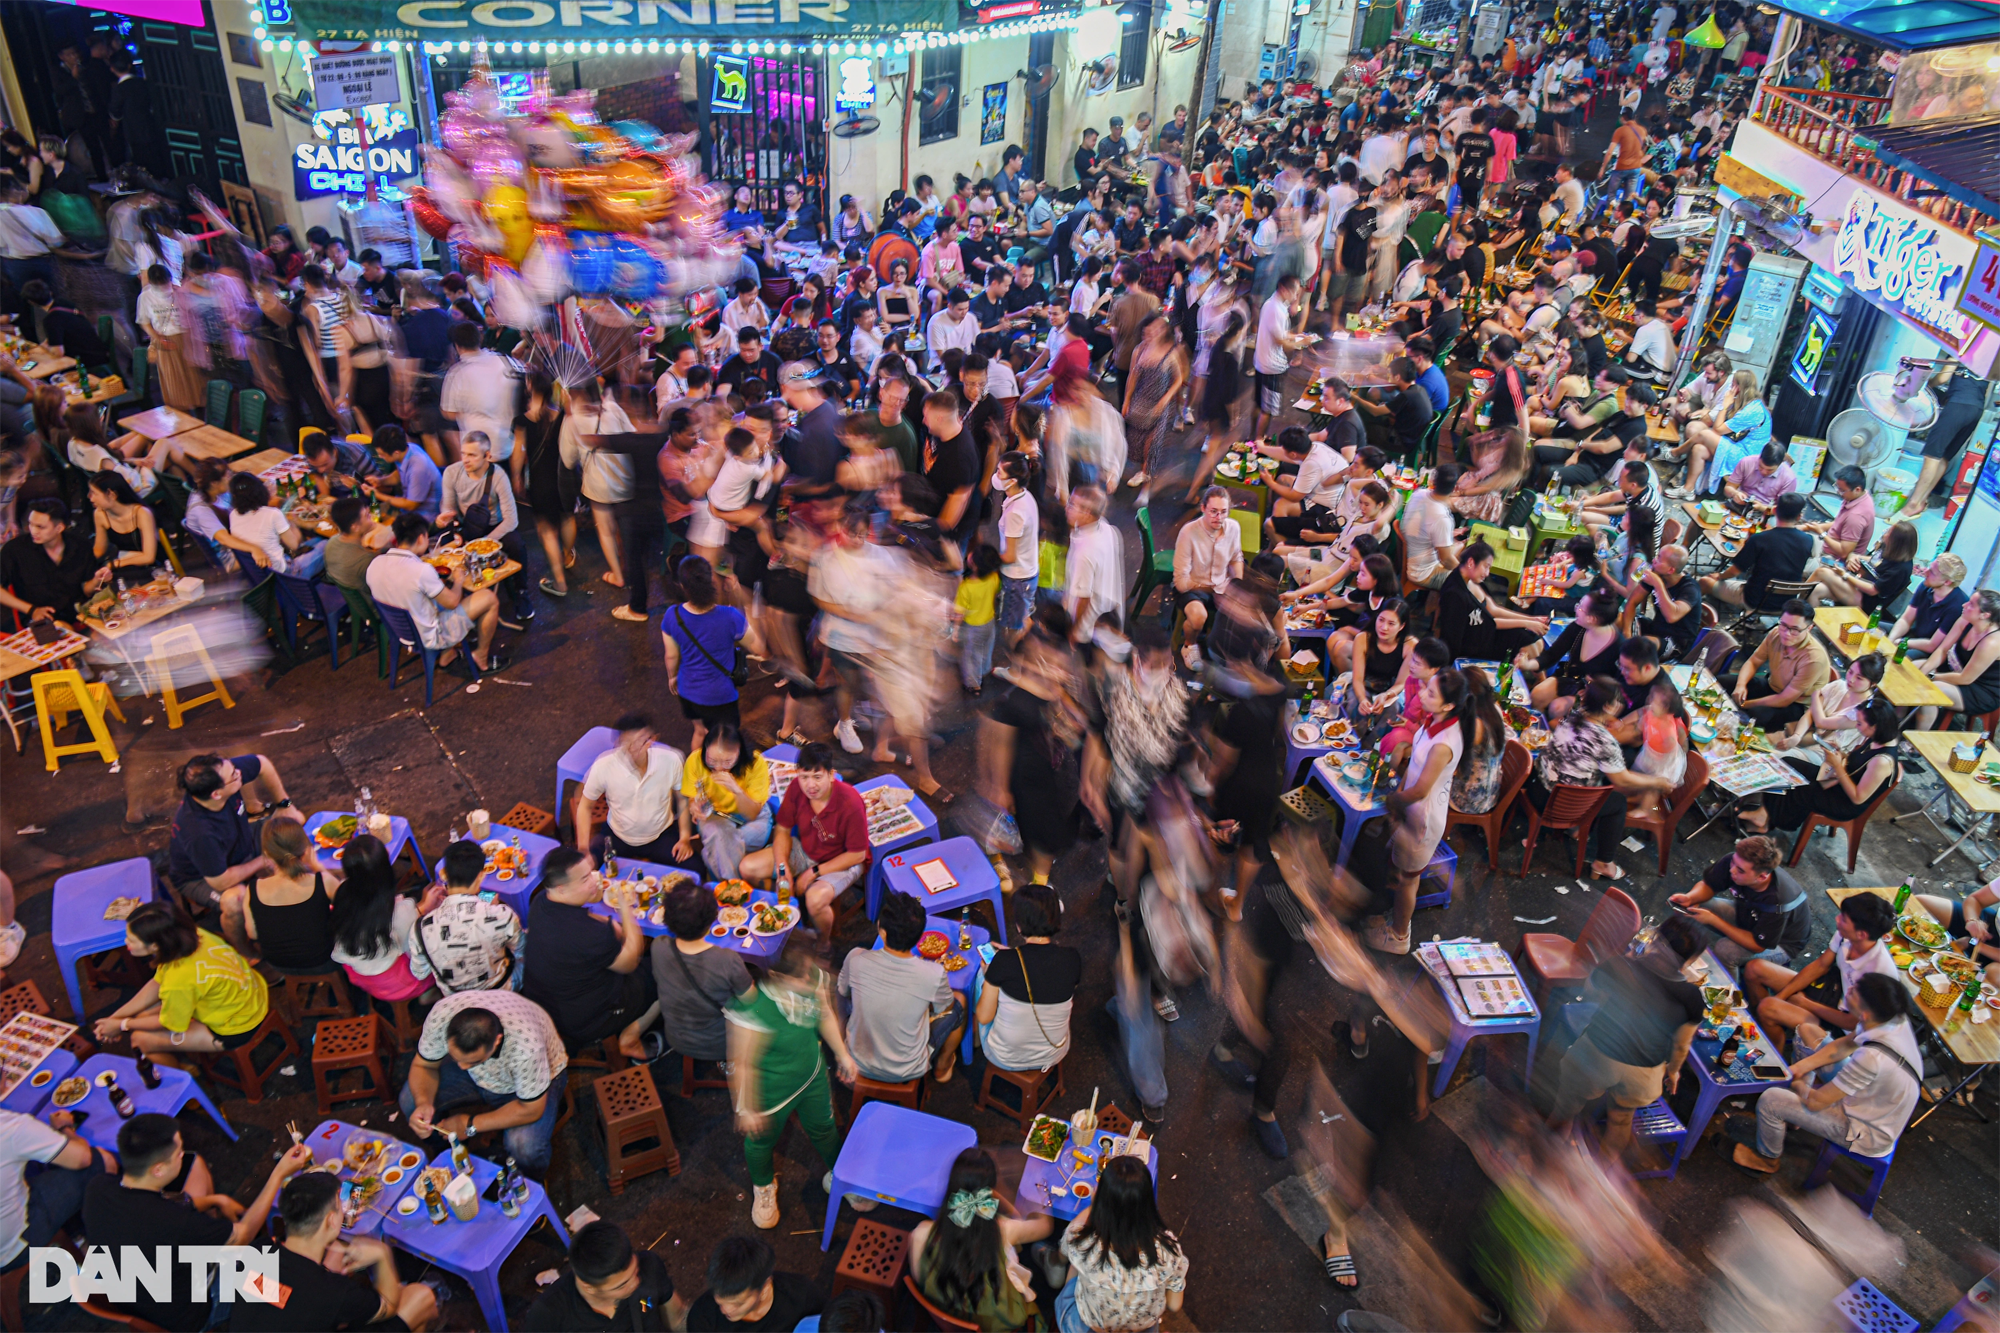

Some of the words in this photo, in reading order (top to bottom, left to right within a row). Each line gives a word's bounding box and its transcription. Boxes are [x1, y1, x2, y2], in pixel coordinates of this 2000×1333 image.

[397, 0, 848, 28] CORNER
[316, 29, 338, 39] 27
[343, 29, 369, 41] TẠ
[374, 28, 419, 40] HIỆN
[851, 23, 872, 33] 27
[877, 23, 898, 34] TẠ
[296, 143, 412, 173] SAIGON
[309, 171, 399, 193] CHIL
[1866, 207, 1957, 300] Tiger
[887, 856, 905, 868] 12
[321, 1123, 340, 1140] 2
